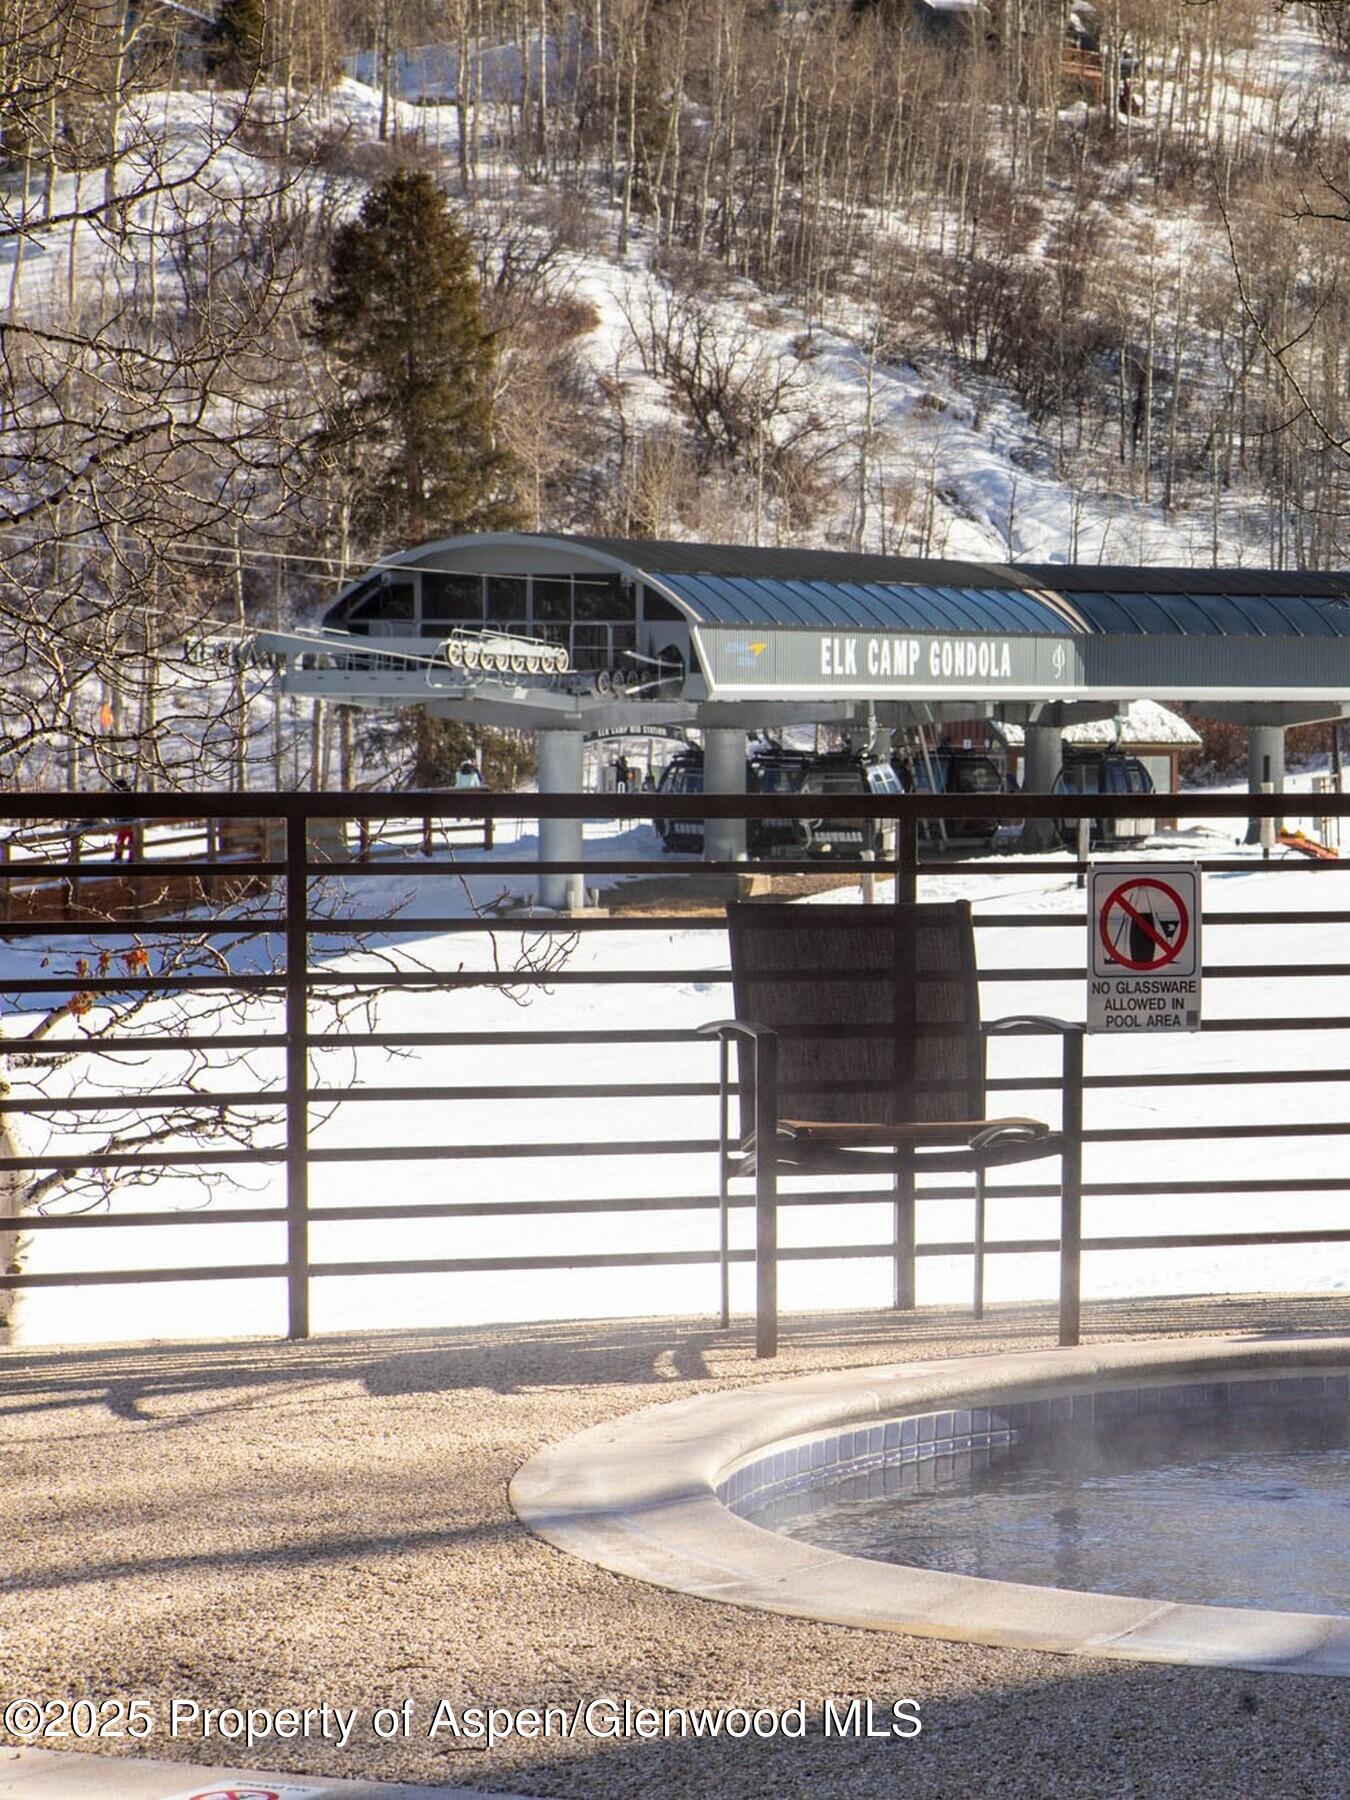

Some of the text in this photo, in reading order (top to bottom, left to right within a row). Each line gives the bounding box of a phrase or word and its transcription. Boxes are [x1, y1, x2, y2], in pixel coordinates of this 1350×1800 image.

[821, 638, 1012, 678] ELK CAMP GONDOLA
[1091, 980, 1197, 995] NO GLASSWARE
[1104, 997, 1185, 1011] ALLOWED IN
[1105, 1013, 1181, 1028] POOL AREA
